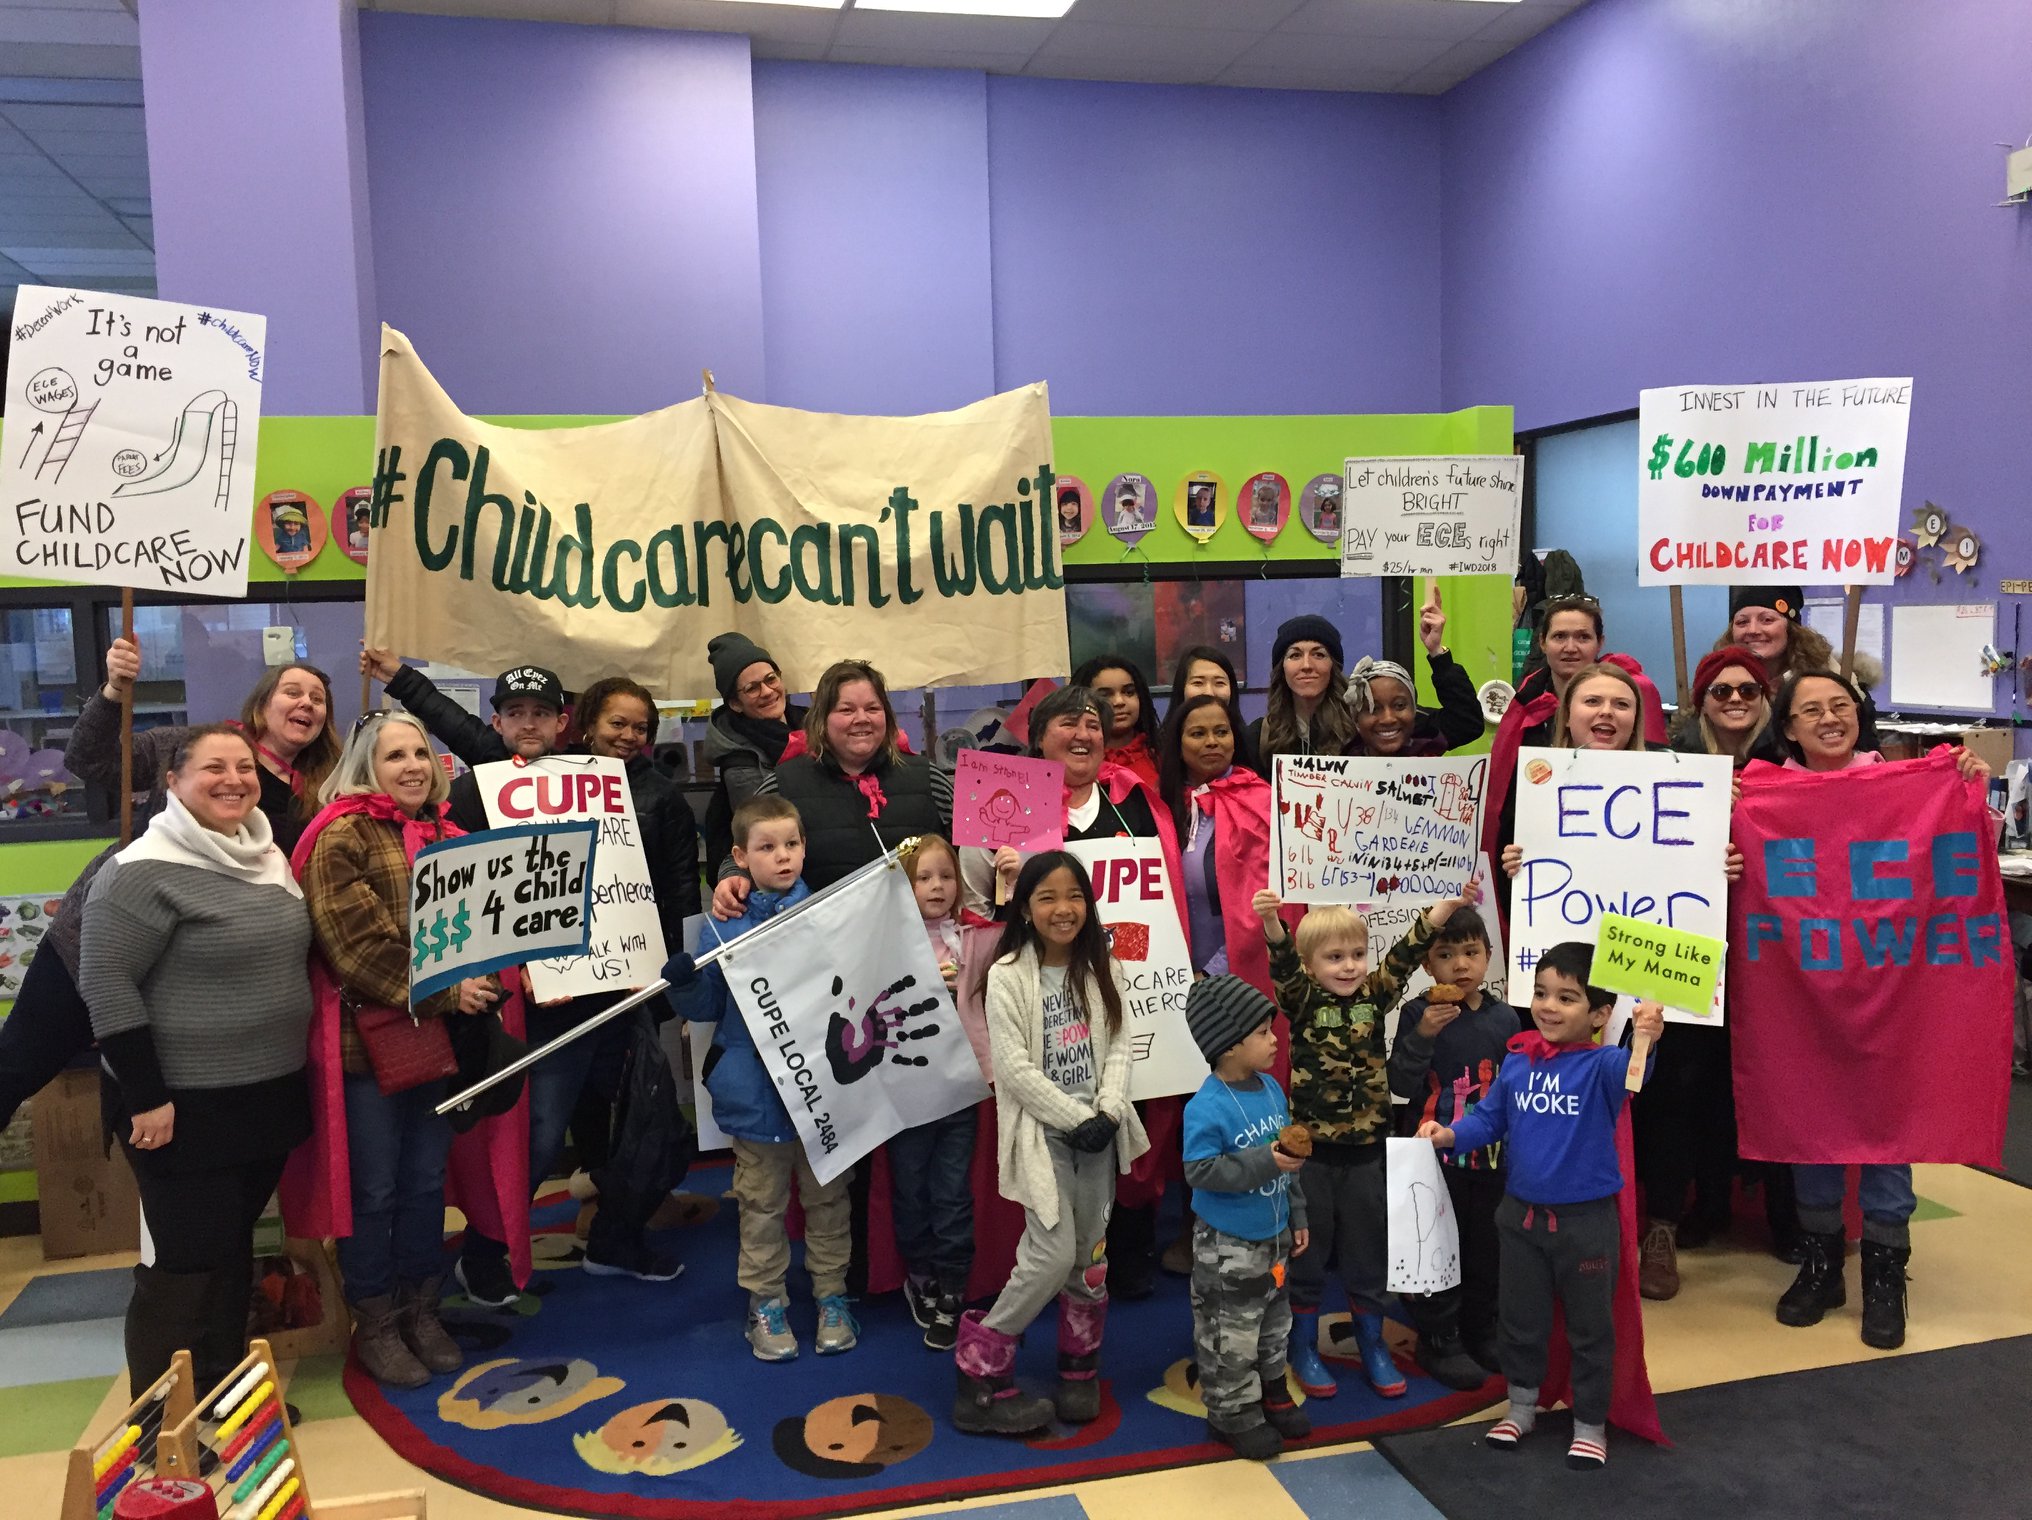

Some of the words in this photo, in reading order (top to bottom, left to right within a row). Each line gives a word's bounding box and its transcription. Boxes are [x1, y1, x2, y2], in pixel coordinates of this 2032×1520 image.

[86, 308, 131, 337] It's
[146, 315, 187, 345] not
[123, 345, 139, 359] a
[32, 377, 58, 392] ECE
[94, 359, 173, 386] game
[34, 386, 75, 405] WAGES
[1680, 391, 1746, 412] INVEST
[1757, 388, 1778, 409] IN
[1793, 388, 1831, 408] THE
[1842, 385, 1911, 407] FUTURE
[1648, 433, 1727, 480] $600
[1744, 435, 1878, 474] Million
[1348, 466, 1375, 489] Let
[1378, 465, 1439, 488] children's
[1446, 463, 1486, 488] future
[16, 498, 115, 536] FUND
[1402, 491, 1468, 512] BRIGHT
[930, 463, 1064, 599] wait
[1748, 514, 1784, 532] FOR
[16, 529, 197, 568] CHILDCARE
[1347, 527, 1378, 553] PAY
[1385, 532, 1410, 549] your
[1479, 528, 1510, 561] right
[1649, 537, 1808, 573] CHILDCARE
[1822, 537, 1894, 573] NOW
[160, 538, 245, 586] NOW
[1449, 561, 1498, 573] #IWD2018
[510, 681, 525, 690] On
[959, 753, 968, 767] I
[970, 761, 988, 773] am
[498, 773, 625, 819] CUPE
[1558, 780, 1704, 847] ECE
[414, 858, 477, 914] Show
[487, 854, 514, 881] us
[524, 834, 571, 873] the
[1764, 831, 1980, 900] ECE
[481, 889, 505, 935] 4
[512, 905, 586, 938] care.
[1607, 926, 1667, 957] Strong
[1675, 943, 1711, 965] Like
[1746, 912, 2001, 970] POWER
[591, 957, 632, 981] US!
[1608, 949, 1637, 977] My
[1643, 959, 1701, 986] Mama
[750, 976, 791, 1041] CUPE
[779, 1038, 823, 1114] LOCAL
[813, 1111, 840, 1156] 2484
[1528, 1072, 1560, 1093] I'M
[1515, 1091, 1580, 1115] WOKE
